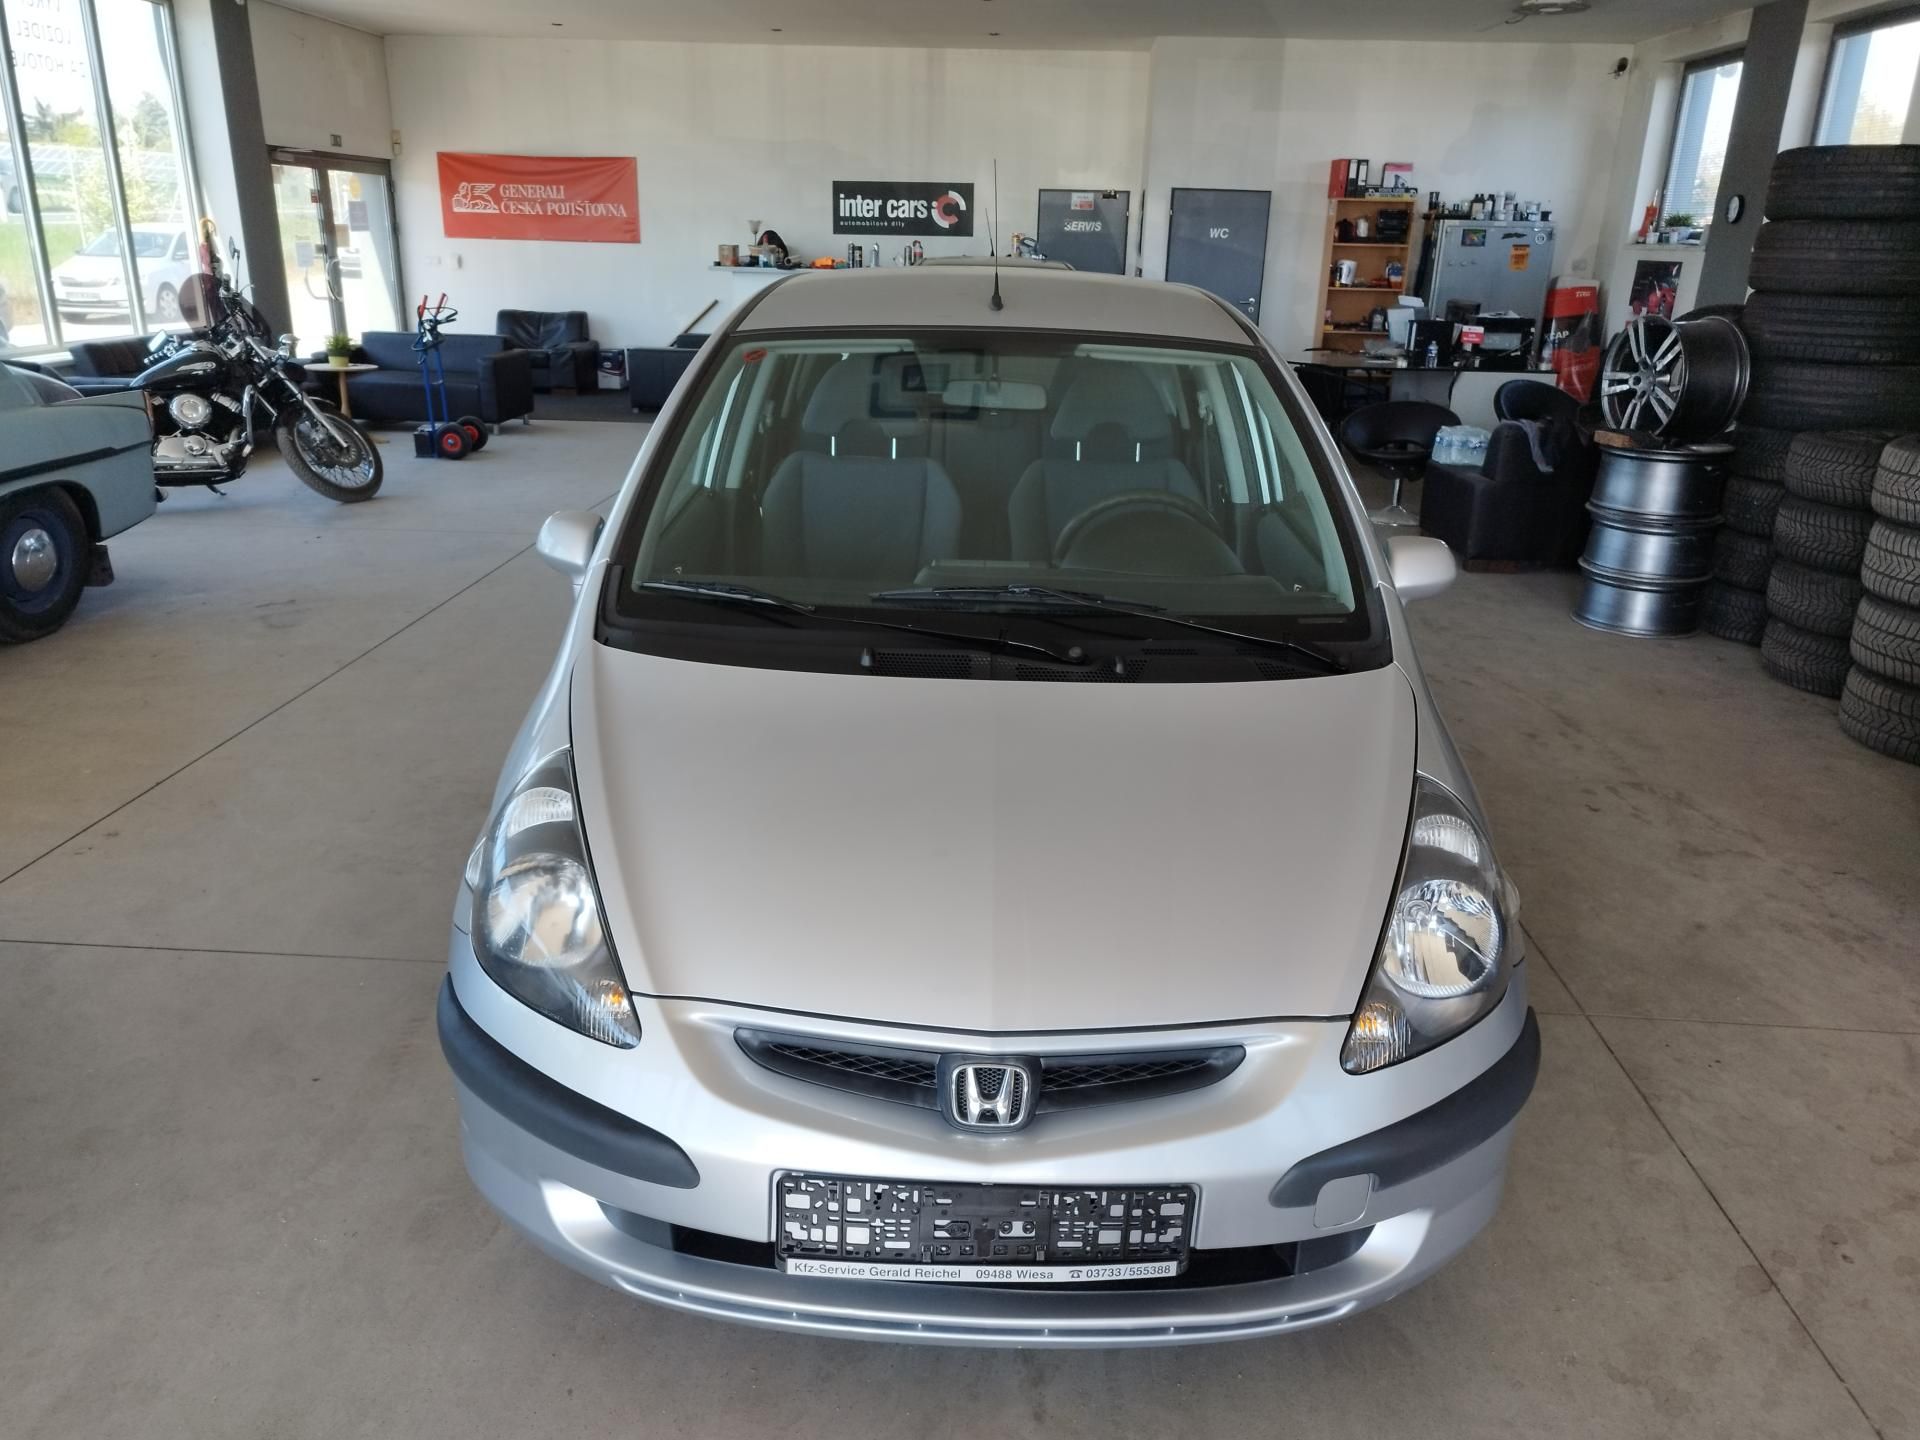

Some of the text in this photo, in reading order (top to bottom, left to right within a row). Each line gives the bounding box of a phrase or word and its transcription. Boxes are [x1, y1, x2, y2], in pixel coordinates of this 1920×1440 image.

[499, 184, 565, 199] GENERALI
[501, 197, 543, 215] ČESKÁ
[839, 193, 928, 218] inter cars
[1063, 218, 1102, 232] SERVIS
[1209, 227, 1230, 239] WC
[794, 1263, 1171, 1279] Kfz-Service Gerald Reichel 09488 Wiesa 03733/555388
